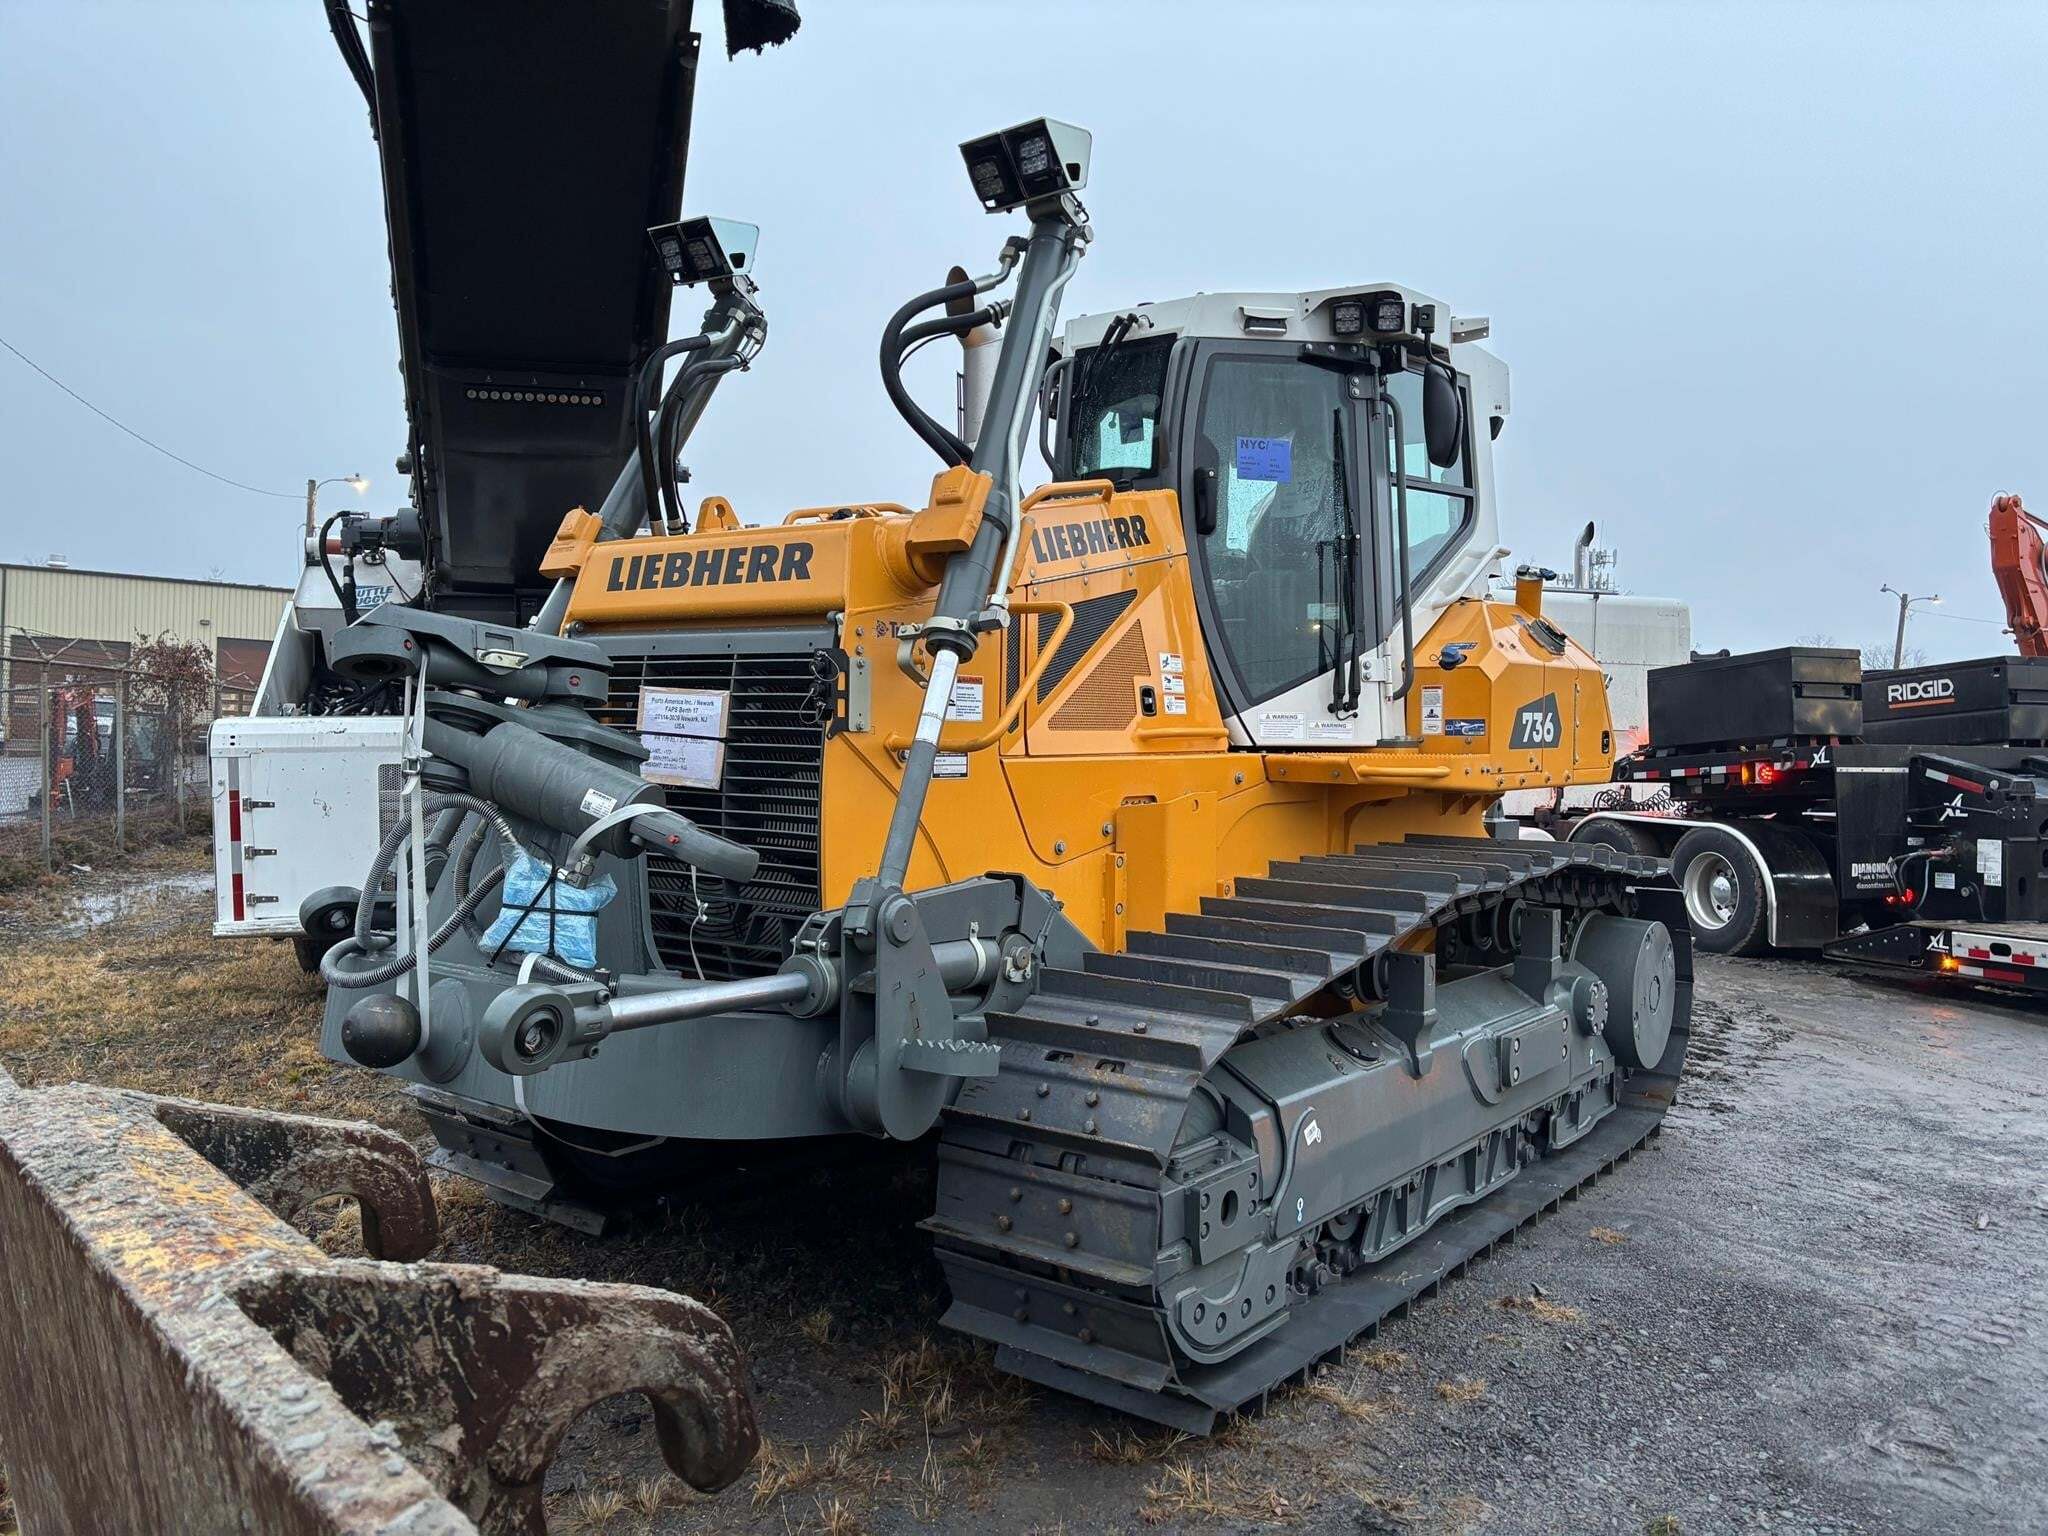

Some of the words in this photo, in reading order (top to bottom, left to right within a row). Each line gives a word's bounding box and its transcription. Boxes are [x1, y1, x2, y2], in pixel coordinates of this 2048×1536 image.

[1031, 514, 1151, 564] LIEBHERR
[606, 541, 814, 592] LIEBHERR
[1887, 678, 1954, 702] RIDGID
[1522, 712, 1554, 743] 736
[1810, 745, 1831, 768] XL
[1851, 862, 1886, 877] DIAMOND
[1926, 931, 1950, 951] XL
